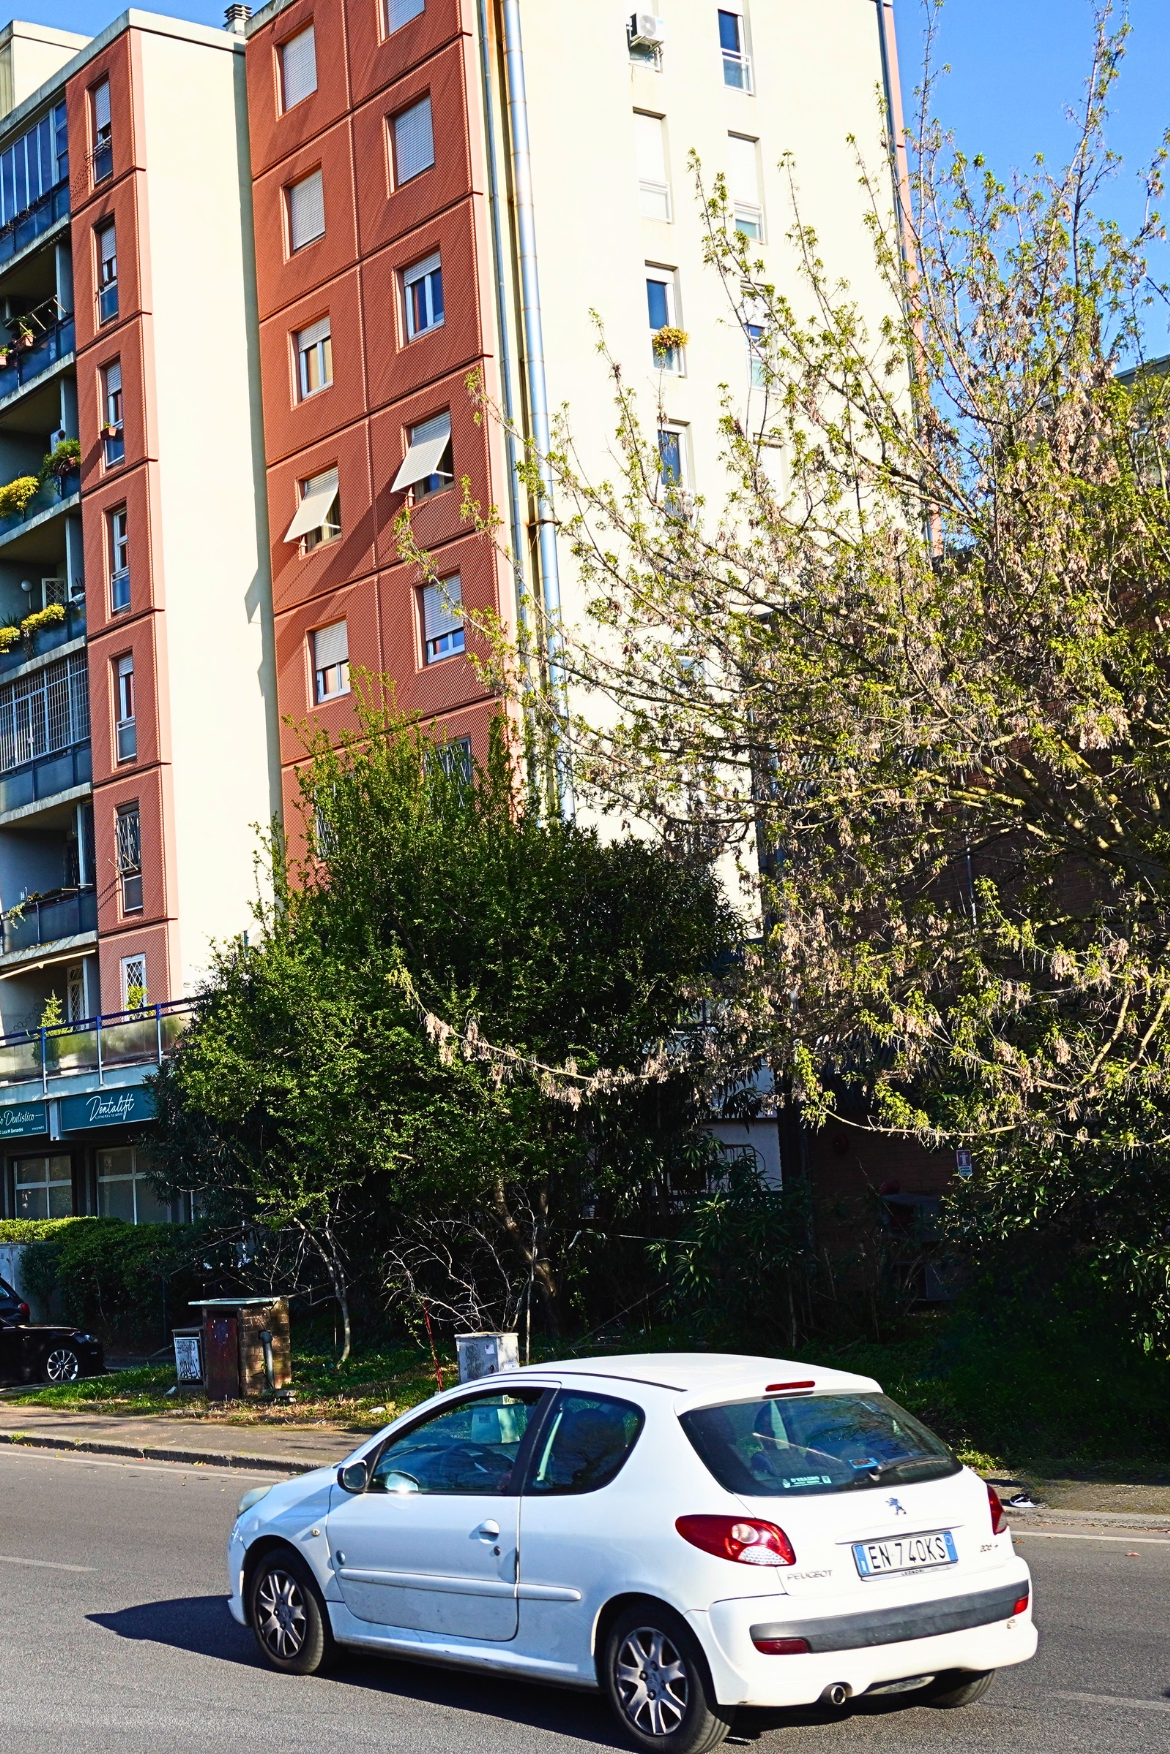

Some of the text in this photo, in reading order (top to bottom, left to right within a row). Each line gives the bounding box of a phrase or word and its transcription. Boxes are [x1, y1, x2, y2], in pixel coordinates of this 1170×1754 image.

[86, 1093, 135, 1121] Dentalift
[868, 1537, 946, 1569] EN 740KS
[787, 1569, 833, 1580] PEUGEOT
